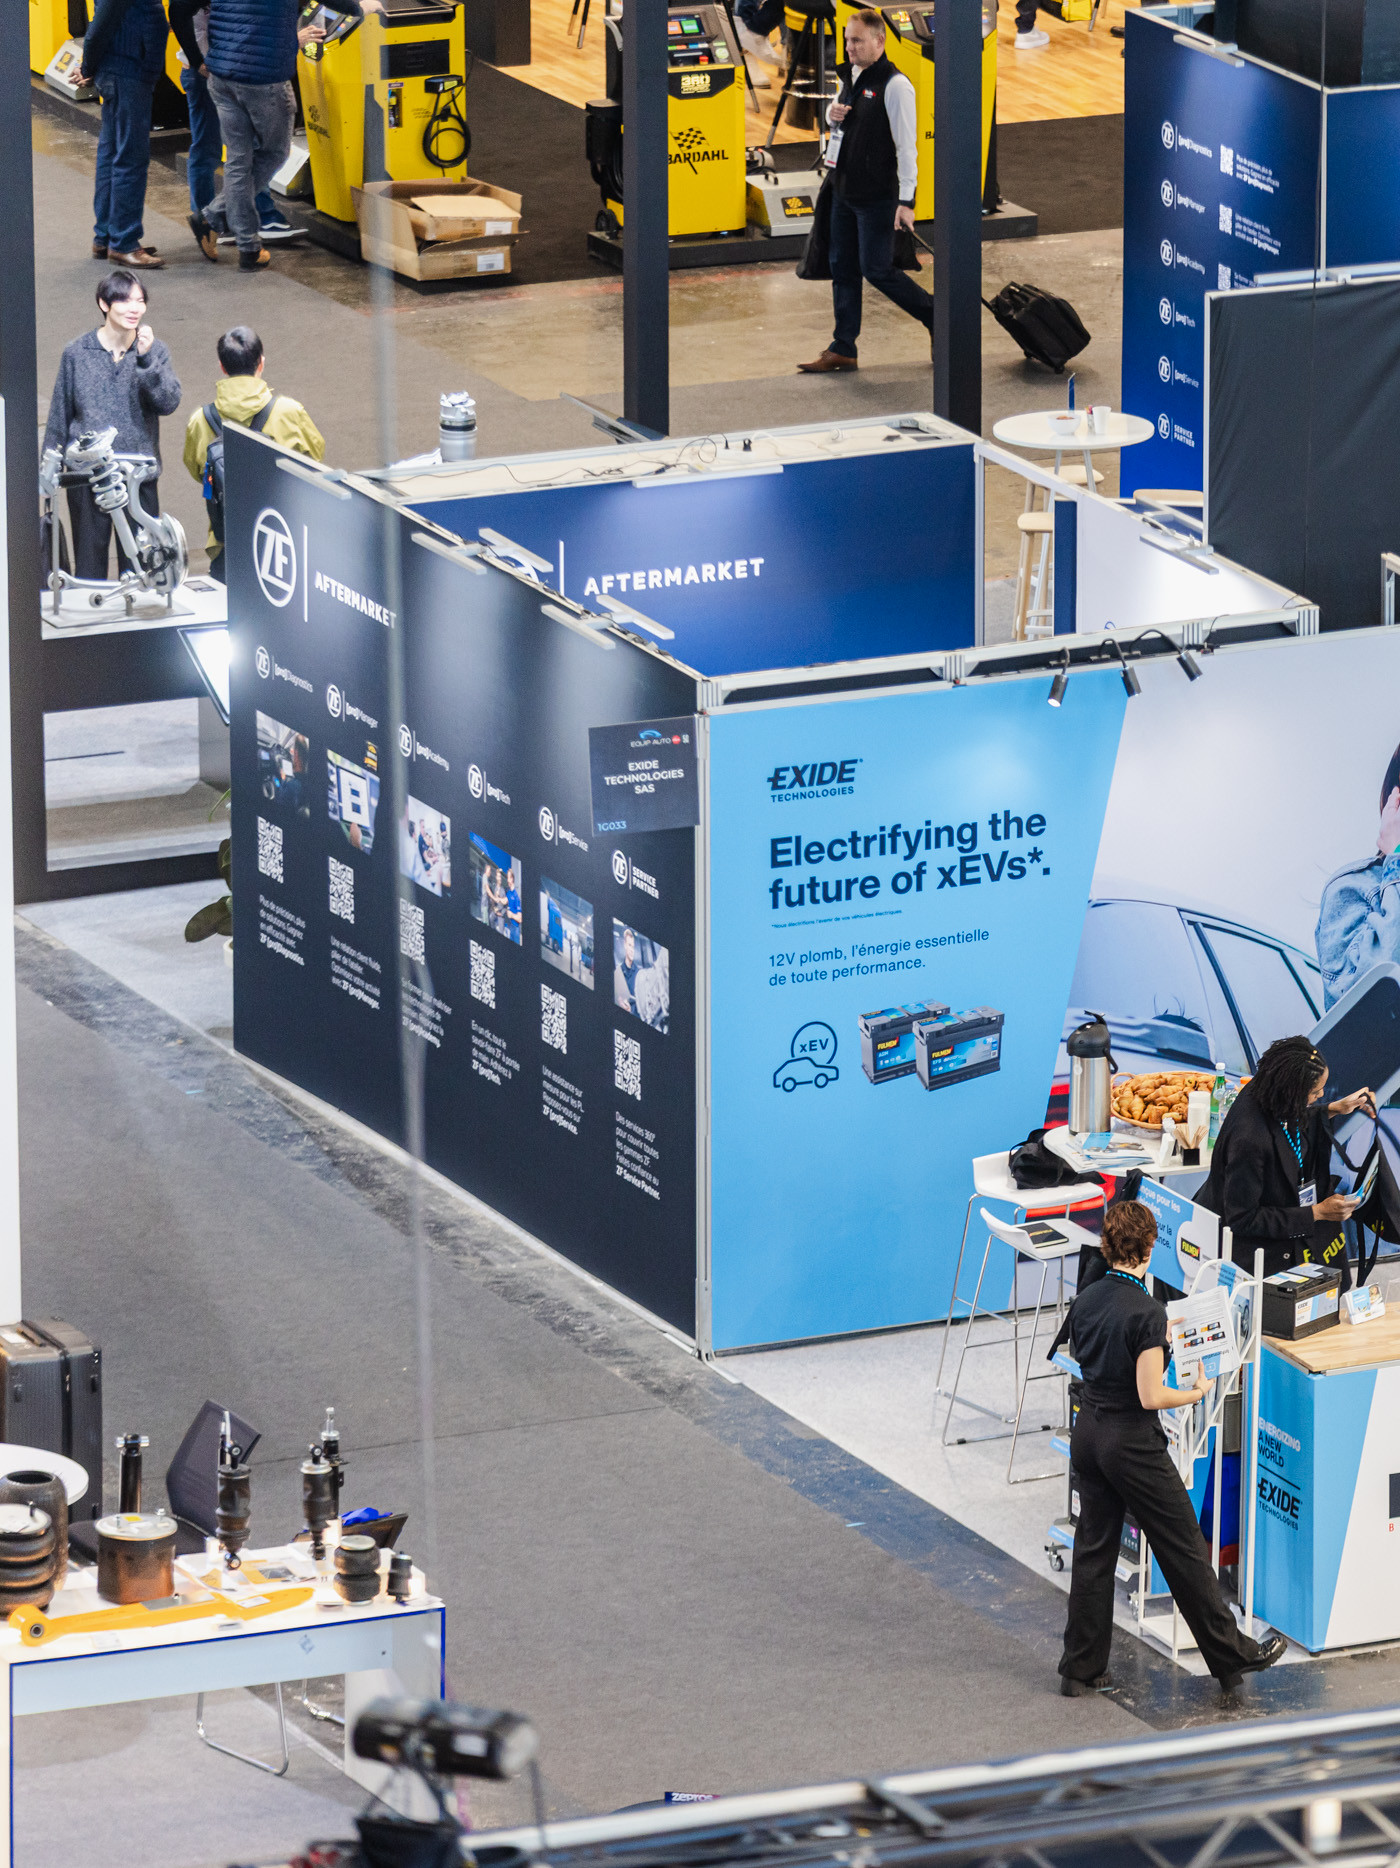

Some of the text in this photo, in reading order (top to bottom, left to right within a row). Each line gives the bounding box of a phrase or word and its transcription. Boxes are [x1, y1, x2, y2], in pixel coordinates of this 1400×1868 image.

[1173, 432, 1195, 448] PARTNER
[1174, 424, 1193, 439] SERVICE
[584, 557, 765, 597] AFTERMARKET
[315, 570, 397, 629] AFTERMARKET
[604, 768, 685, 786] TECHNOLOGIES
[628, 759, 659, 772] EXIDE
[766, 758, 859, 791] EXIDE
[634, 783, 656, 795] SAS
[770, 785, 855, 803] TECHNOLOGIES
[597, 820, 627, 833] 1G033
[770, 809, 1047, 869] Electrifying the
[632, 866, 657, 888] SERVICE
[632, 876, 660, 900] PARTNER
[769, 873, 881, 910] future
[890, 860, 928, 895] of
[768, 928, 990, 968] 12V plomb, l'énergie essentielle
[768, 956, 926, 987] de toute performance.
[798, 1038, 830, 1055] xEV
[1156, 1193, 1181, 1214] pour les
[1166, 1223, 1173, 1236] la
[1258, 1416, 1301, 1452] ENERGIZING
[1258, 1431, 1282, 1454] A NEW
[1258, 1445, 1285, 1468] WORLD
[1257, 1477, 1300, 1520] EXIDE
[1258, 1502, 1299, 1531] TECHNOLOGIES
